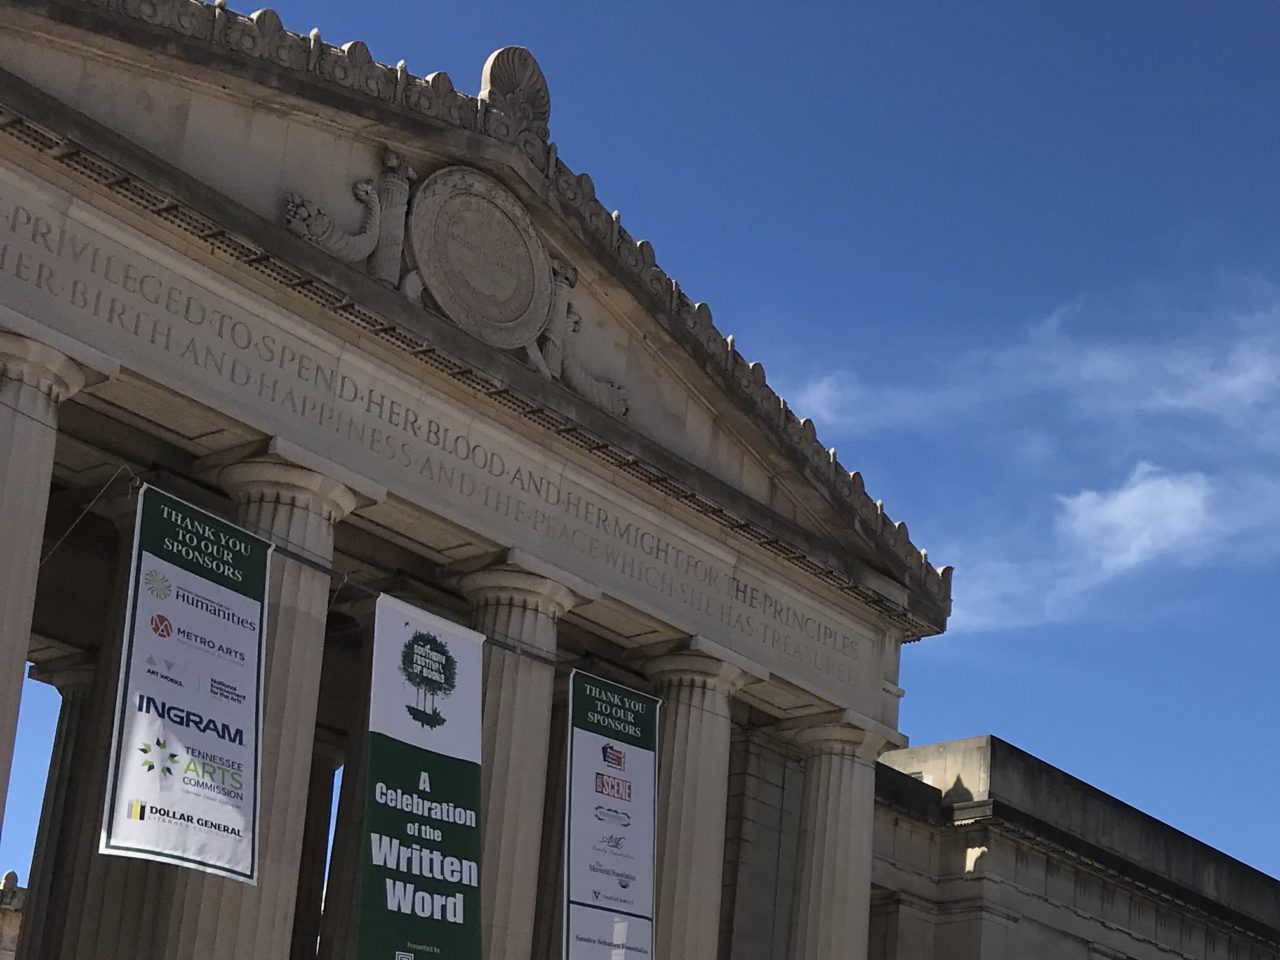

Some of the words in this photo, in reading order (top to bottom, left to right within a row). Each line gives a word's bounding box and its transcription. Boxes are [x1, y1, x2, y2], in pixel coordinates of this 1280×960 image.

[10, 205, 208, 326] PRIVILEGED
[213, 310, 253, 351] TO
[261, 335, 359, 403] SPEND
[365, 388, 421, 438] HER
[425, 420, 505, 478] BLOOD
[509, 465, 561, 507] AND
[563, 491, 610, 537] HER
[612, 516, 684, 569] MIGHT
[684, 554, 720, 588] FOR
[723, 573, 760, 609] THE
[761, 594, 859, 662] PRINCIPLES
[70, 279, 173, 352] BIRTH
[181, 337, 252, 387] AND
[257, 373, 413, 468] HAPPINESS
[419, 456, 476, 498] AND
[478, 484, 527, 522] THE
[532, 508, 600, 560] PEACE
[604, 543, 675, 598] WHICH
[718, 604, 755, 637] HAS
[160, 503, 216, 541] THANK
[218, 531, 252, 556] YOU
[175, 526, 198, 547] TO
[200, 540, 234, 564] OUR
[163, 536, 243, 582] SPONSORS
[175, 589, 256, 632] Humanities
[176, 626, 215, 650] METRO
[216, 643, 246, 662] ARTS
[412, 663, 422, 675] OF
[584, 683, 623, 706] THANK
[623, 697, 647, 714] YOU
[595, 700, 611, 715] TO
[612, 707, 635, 723] OUR
[137, 693, 244, 746] INGRAM
[587, 711, 642, 738] SPONSORS
[183, 757, 243, 790] ARTS
[184, 746, 244, 772] TENNESSEE
[182, 775, 244, 801] COMMISSION
[418, 770, 432, 793] A
[602, 775, 631, 801] SCENE
[149, 804, 195, 824] DOLLAR
[195, 817, 243, 838] GENERAL
[375, 782, 476, 828] Celebration
[406, 822, 420, 837] of
[420, 825, 443, 842] the
[370, 832, 479, 888] Written
[385, 878, 464, 924] Word
